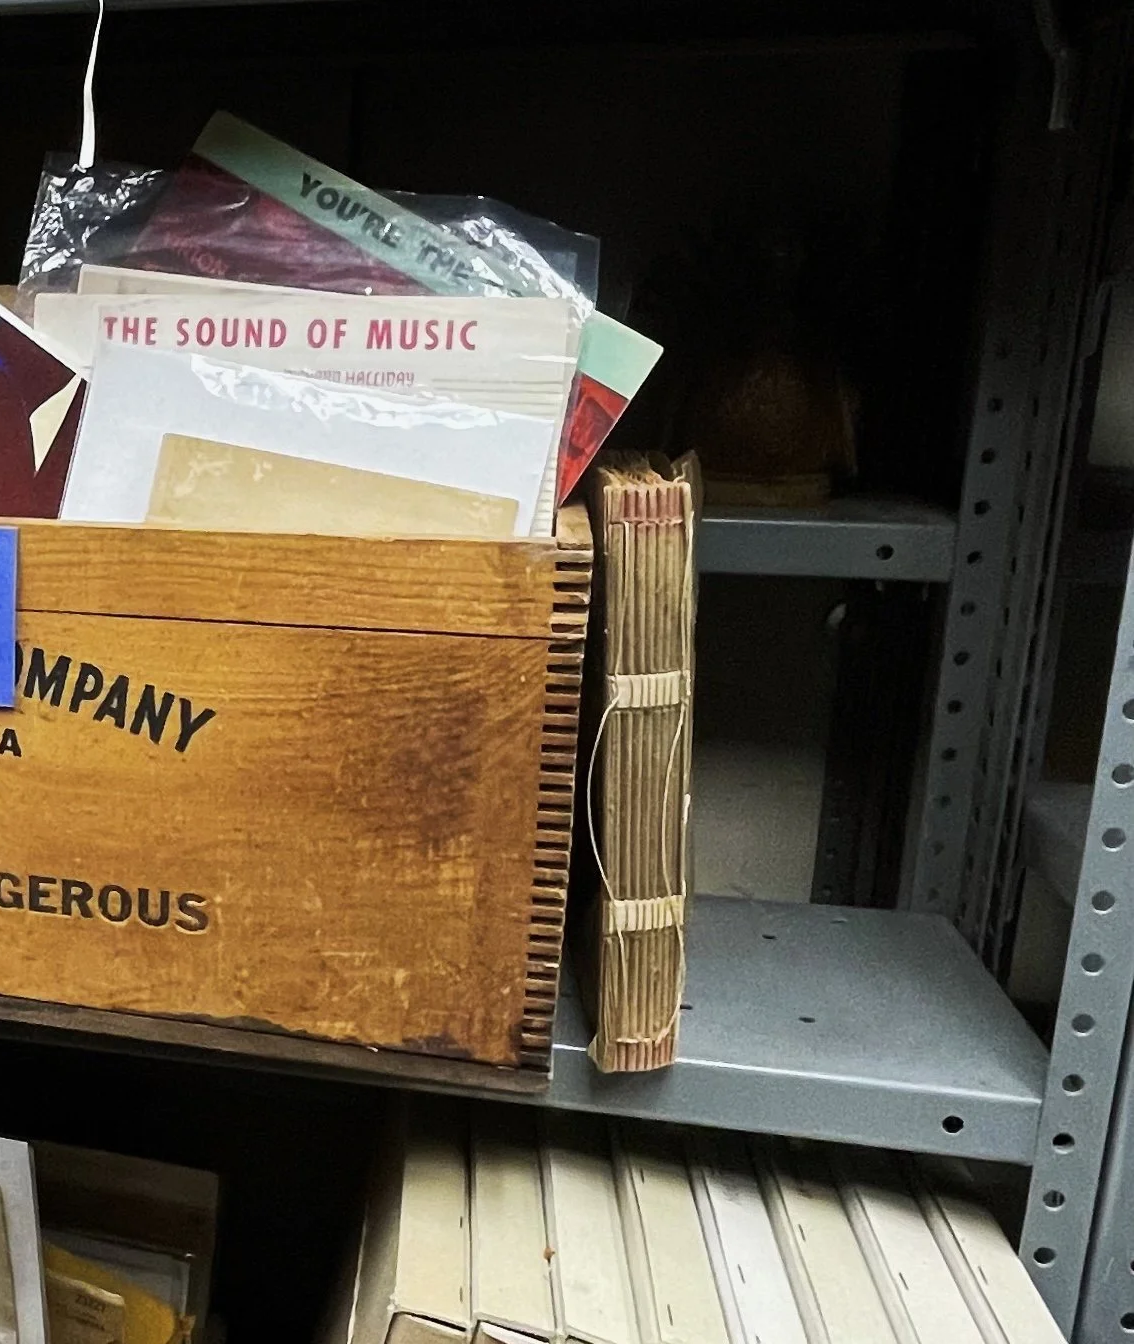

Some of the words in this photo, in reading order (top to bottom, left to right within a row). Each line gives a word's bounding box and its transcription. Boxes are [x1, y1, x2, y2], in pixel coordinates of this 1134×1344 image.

[301, 172, 406, 248] YOU'RE
[103, 316, 157, 347] THE
[175, 316, 287, 349] SOUND
[307, 318, 348, 349] OF
[366, 319, 479, 350] MUSIC
[344, 370, 416, 387] HALLIDAY
